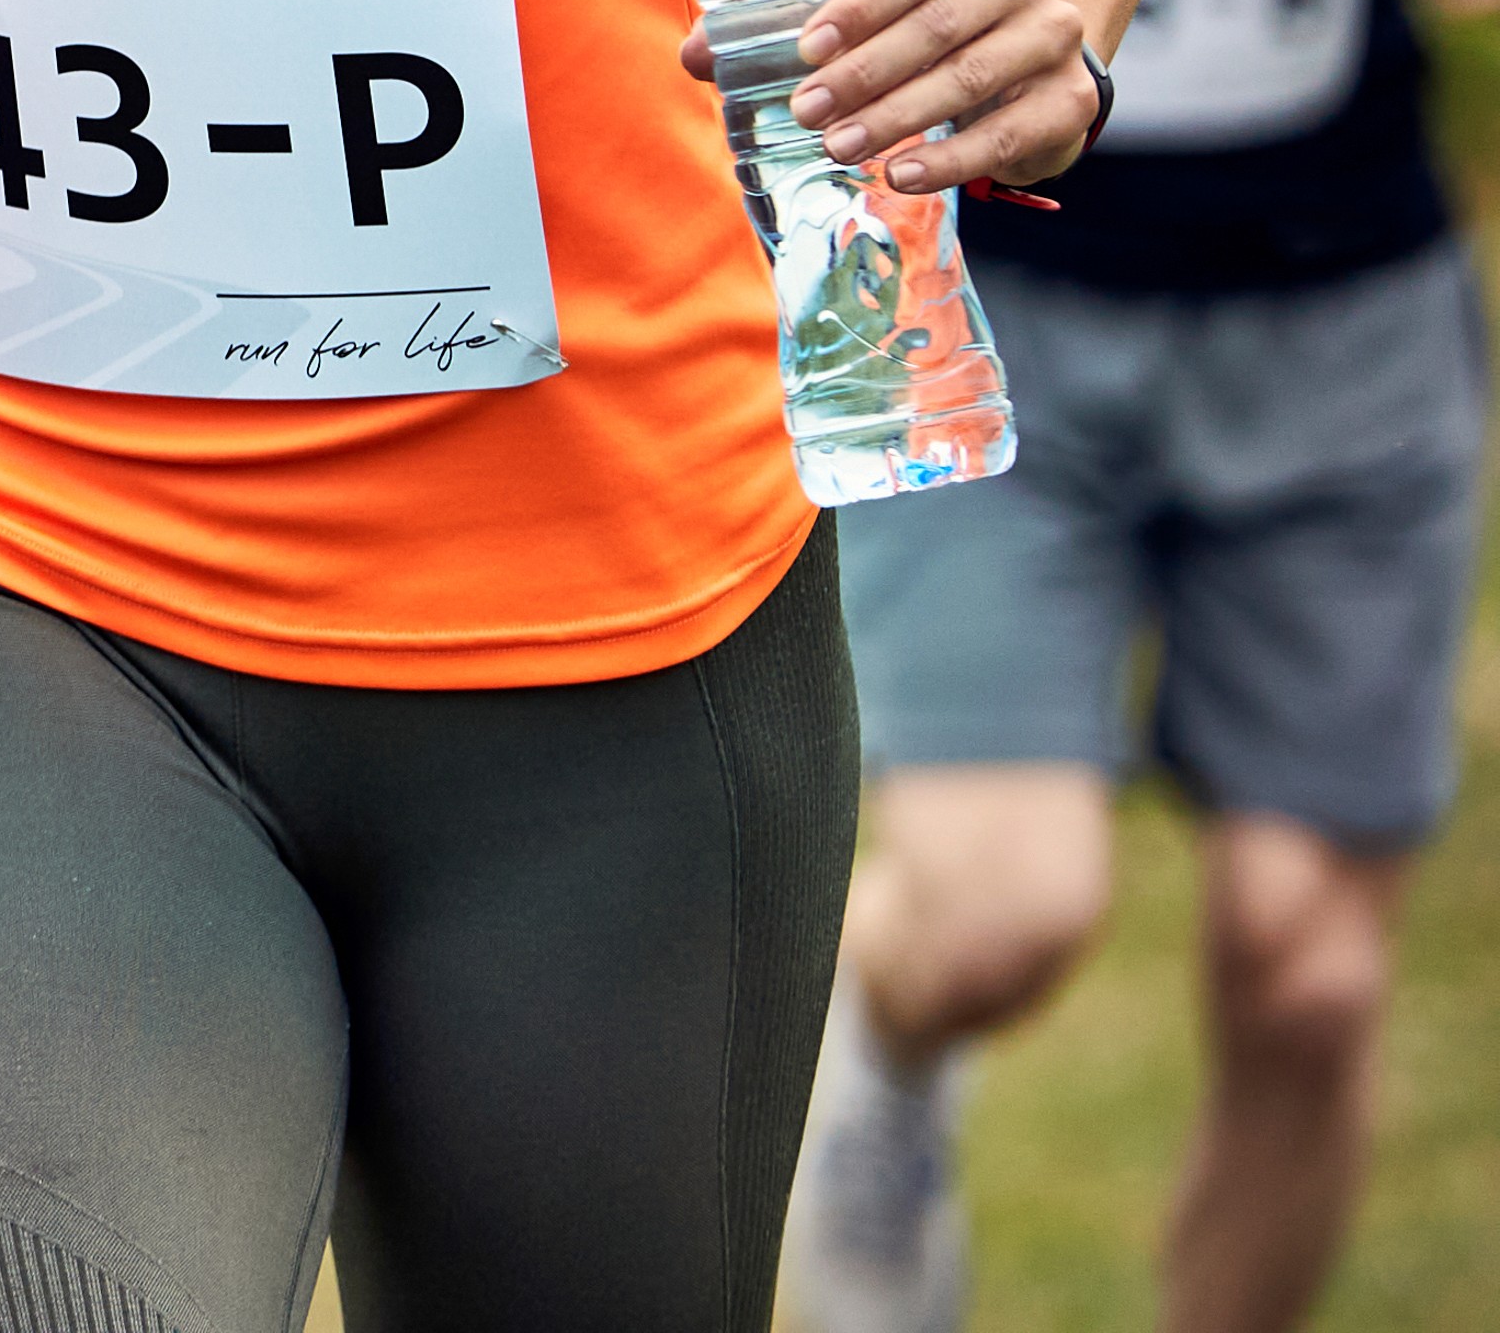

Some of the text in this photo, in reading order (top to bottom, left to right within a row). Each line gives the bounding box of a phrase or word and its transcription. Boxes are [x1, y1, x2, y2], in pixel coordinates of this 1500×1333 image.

[224, 301, 501, 379] run for life
